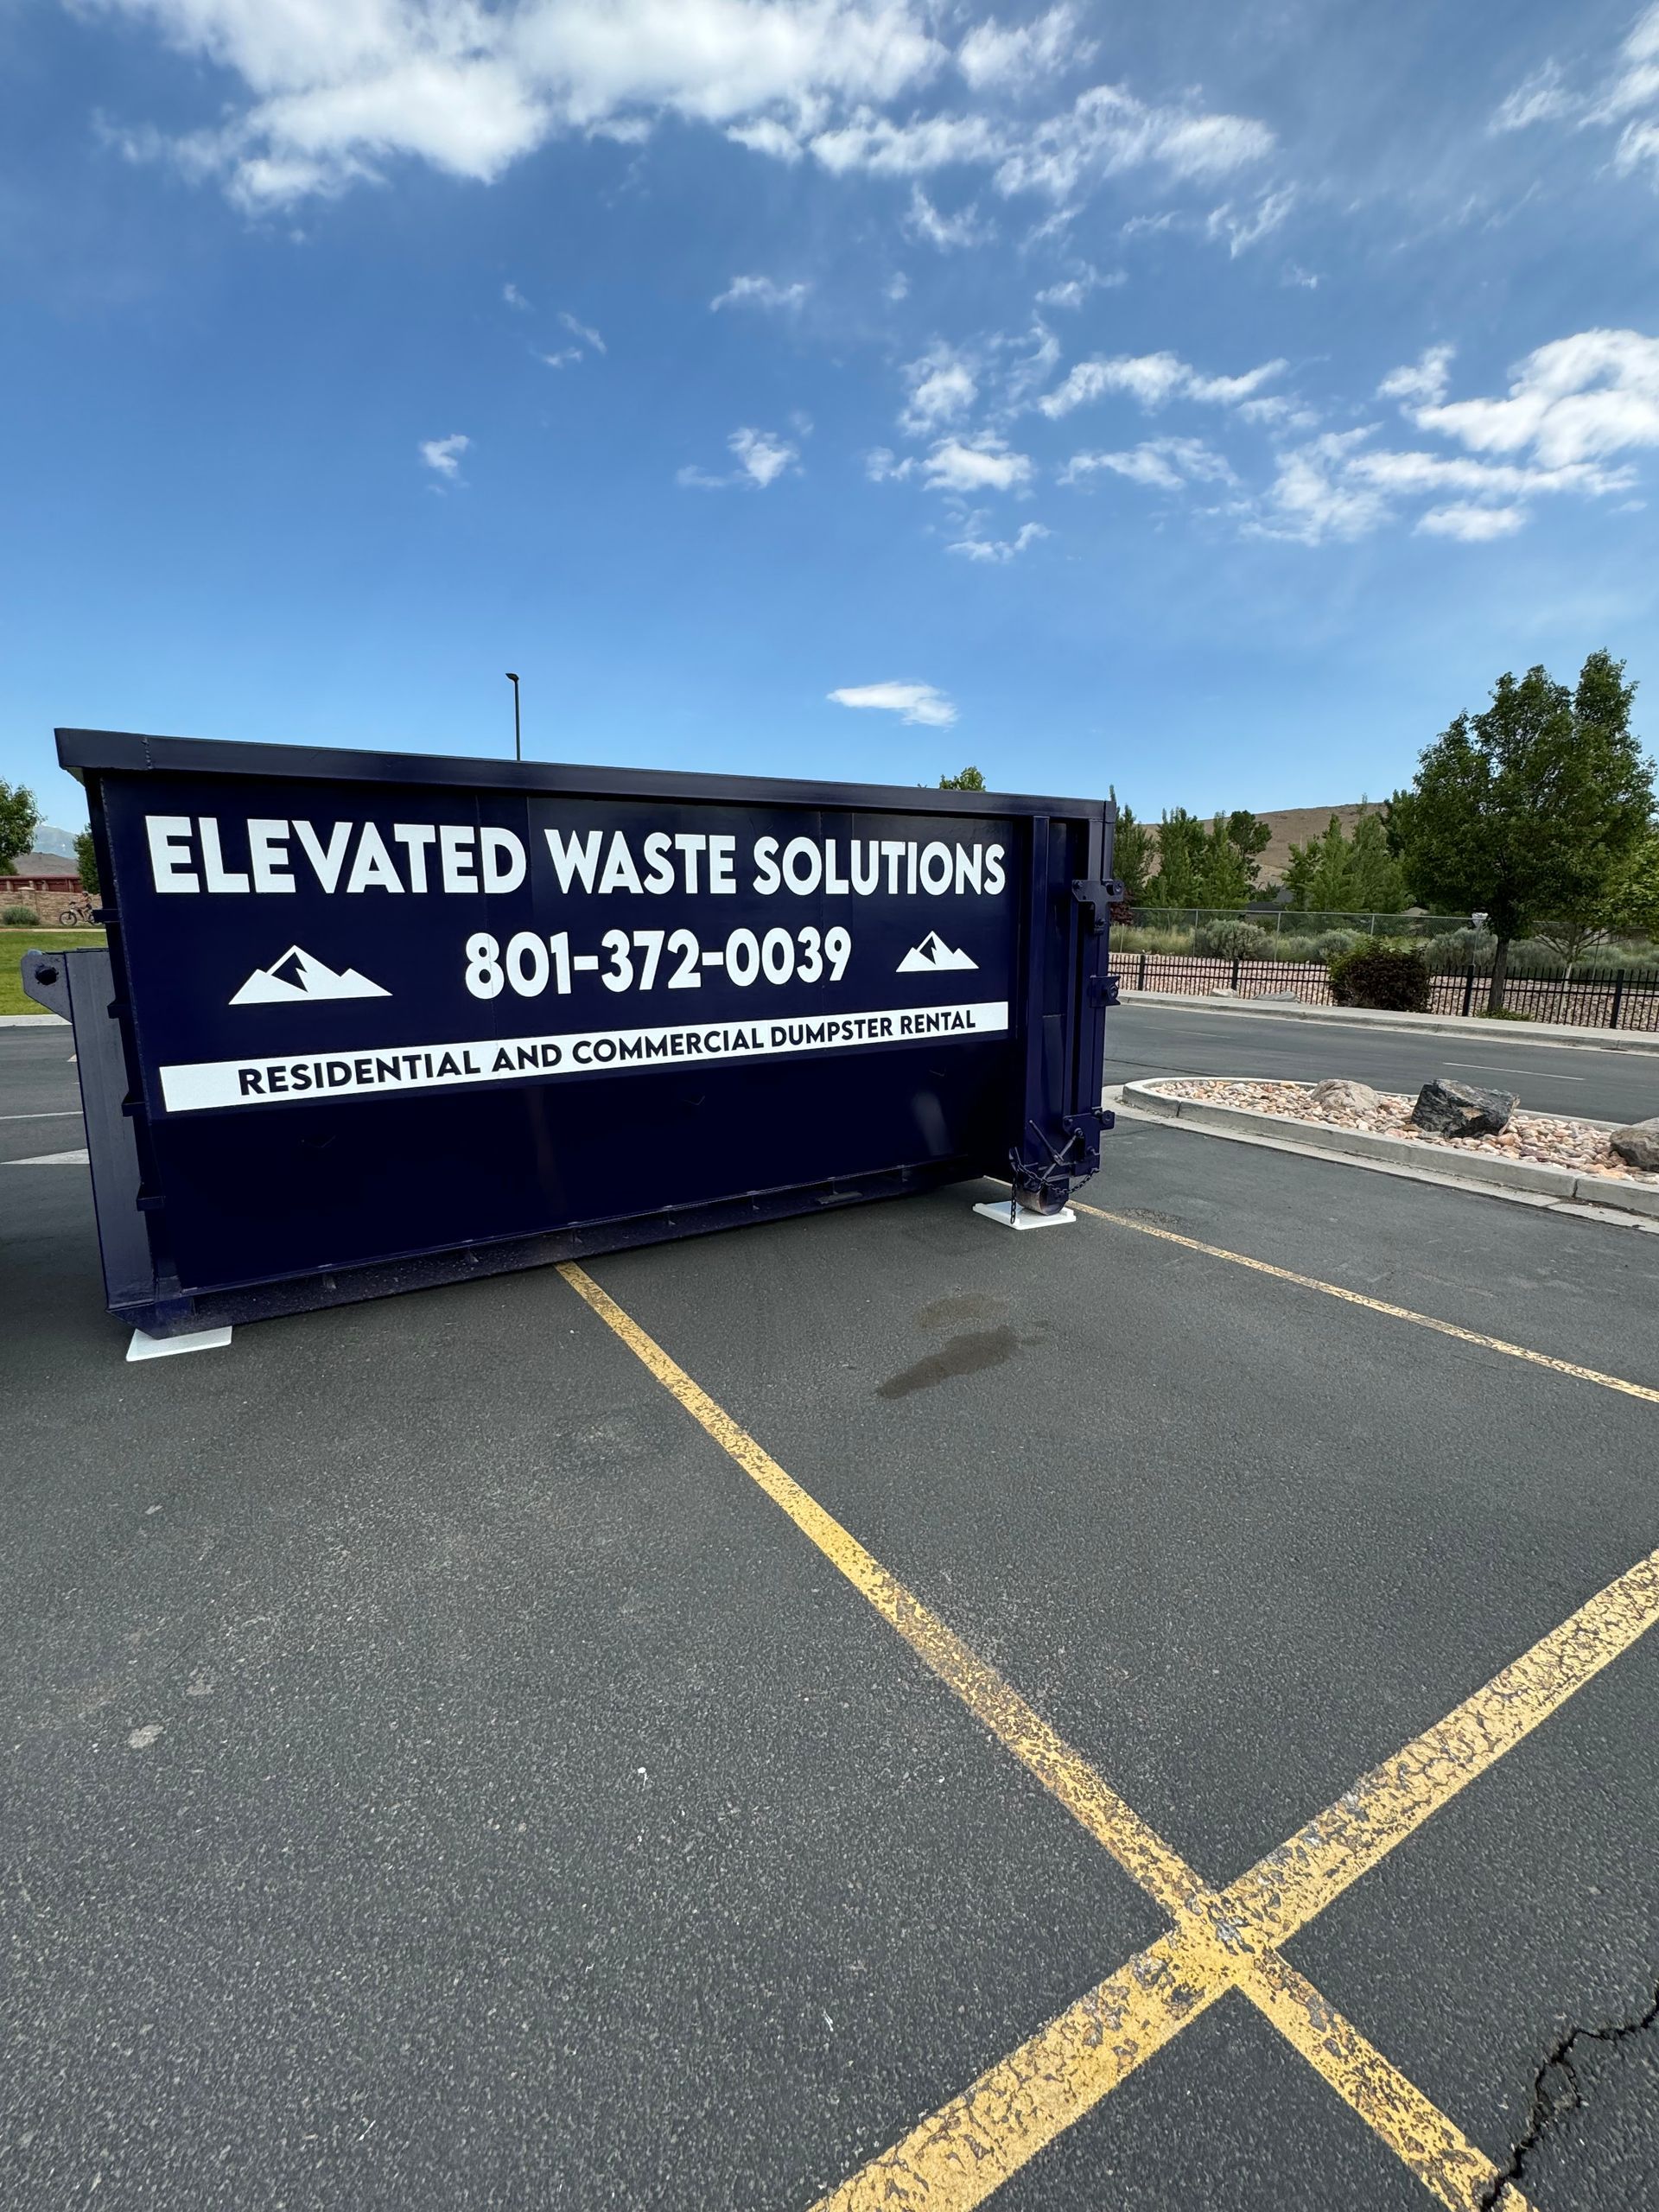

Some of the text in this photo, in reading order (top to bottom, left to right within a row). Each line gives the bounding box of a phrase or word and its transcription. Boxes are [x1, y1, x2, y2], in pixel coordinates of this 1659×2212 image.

[144, 815, 1006, 897] ELEVATED WASTE SOLUTIONS
[465, 927, 853, 1001] 801-372-0039
[238, 1009, 977, 1096] RESIDENTIAL AND COMMERCIAL DUMPSTER RENTAL
